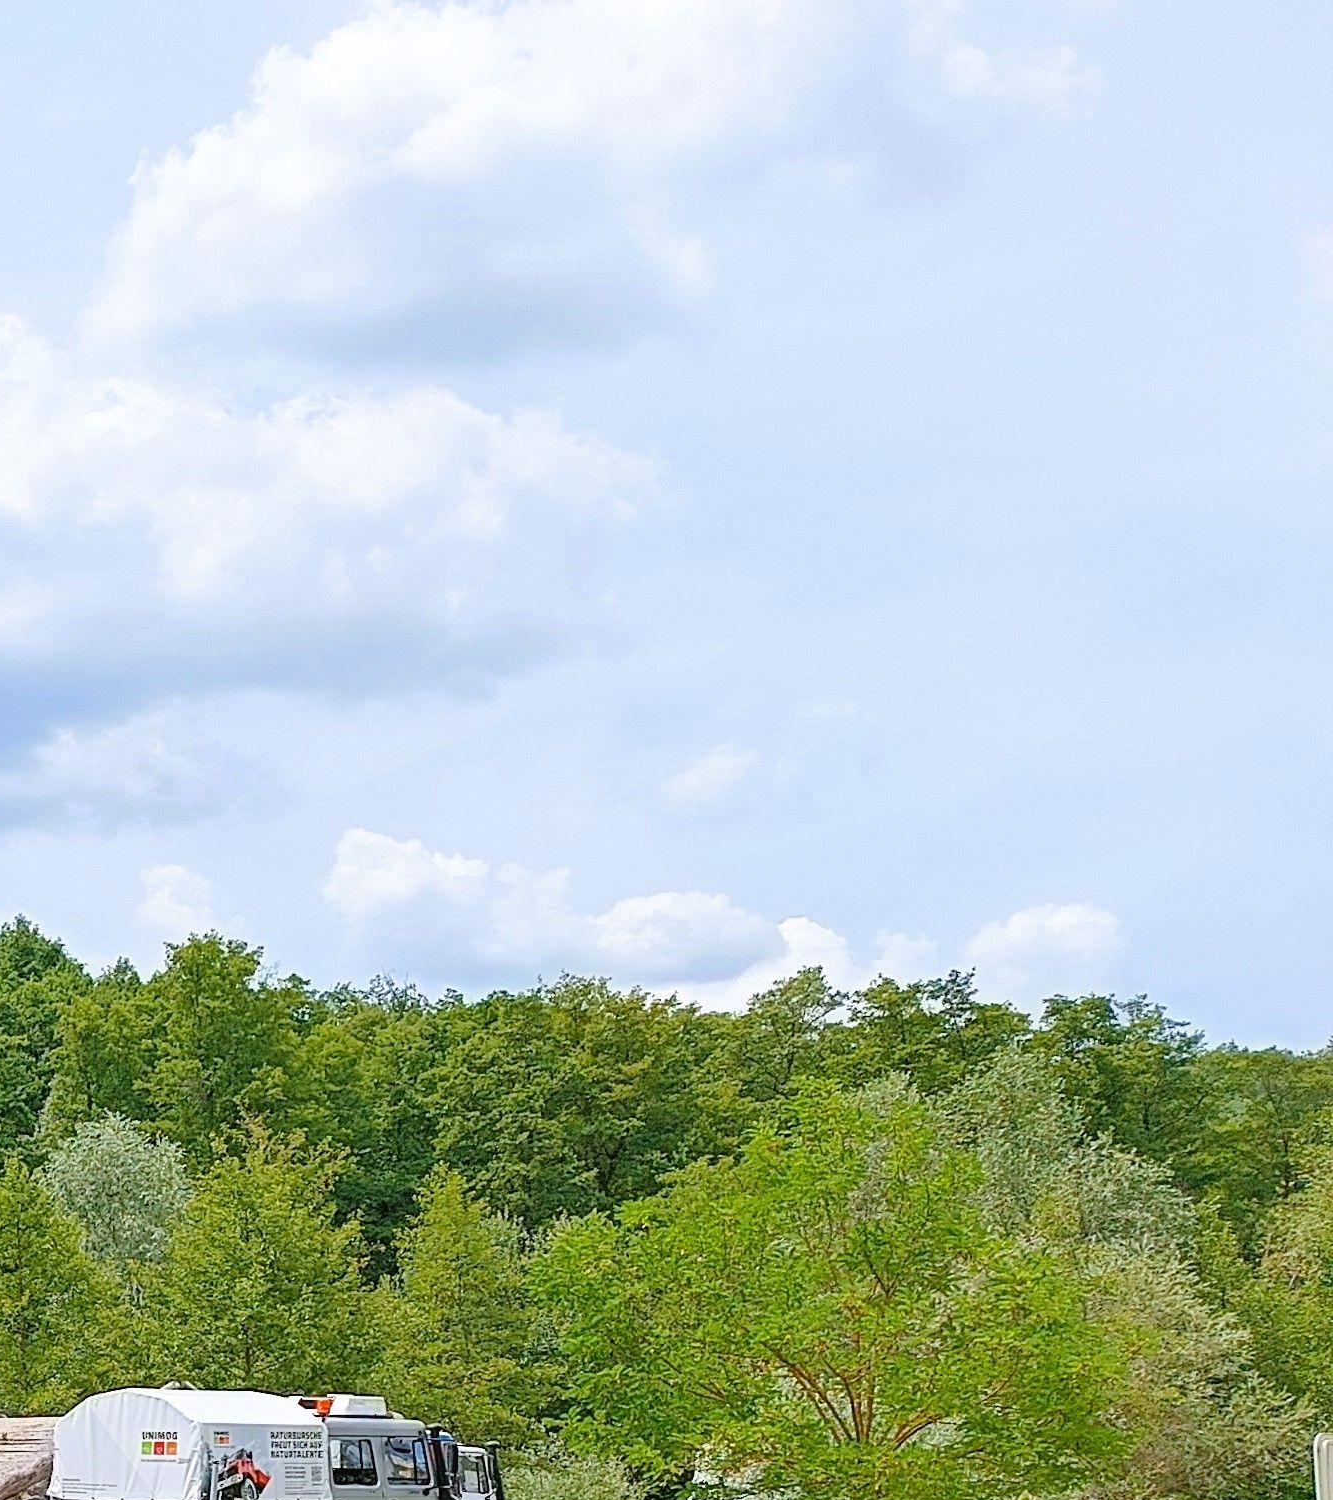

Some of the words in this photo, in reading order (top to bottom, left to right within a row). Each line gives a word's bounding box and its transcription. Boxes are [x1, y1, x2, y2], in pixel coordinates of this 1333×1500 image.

[141, 1431, 178, 1440] UNIMOG
[270, 1431, 323, 1440] NATURBURSCHE
[293, 1441, 308, 1449] SICH
[309, 1441, 323, 1449] AUF
[270, 1450, 324, 1459] NATURTALENTE
